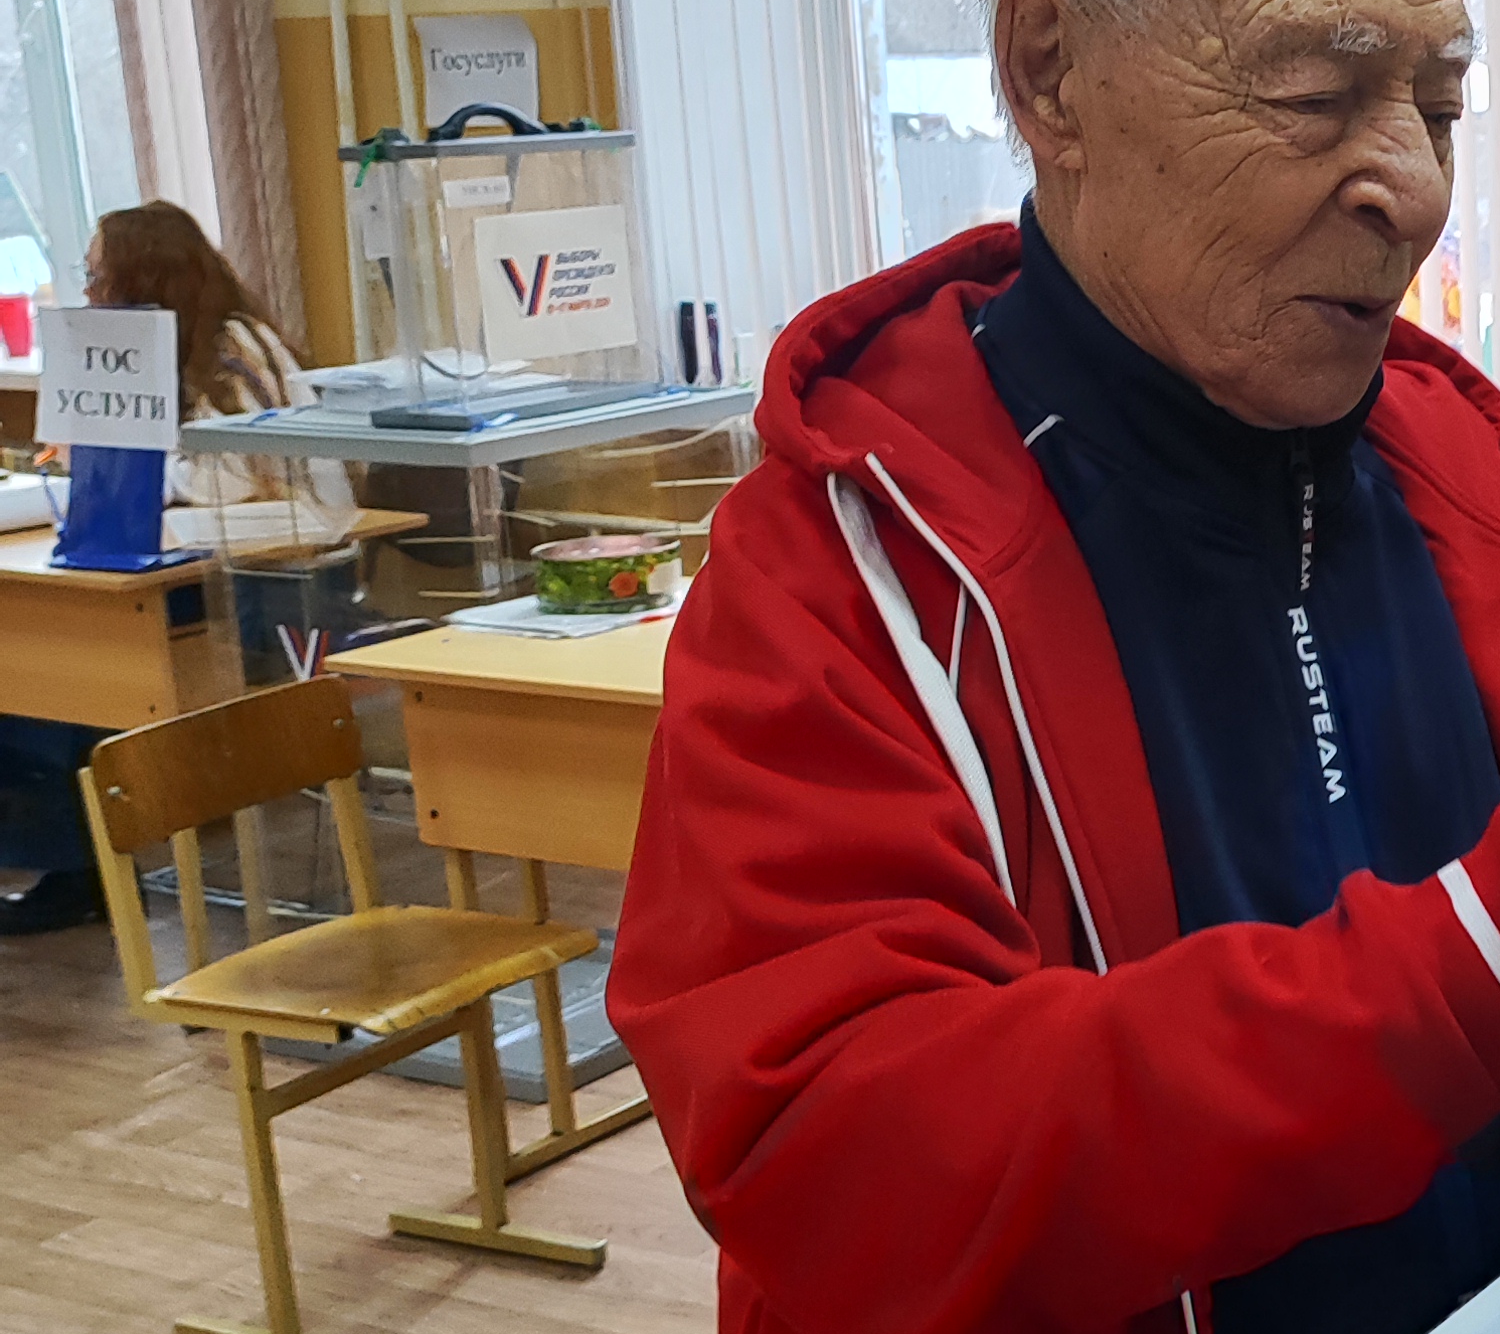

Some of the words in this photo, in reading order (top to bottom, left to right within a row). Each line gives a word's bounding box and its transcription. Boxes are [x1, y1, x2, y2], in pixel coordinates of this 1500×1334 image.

[430, 48, 527, 76] Госуслуги
[85, 346, 141, 374] ГОС
[57, 389, 166, 420] УСЛУГИ
[1287, 605, 1347, 804] RUSTEAM
